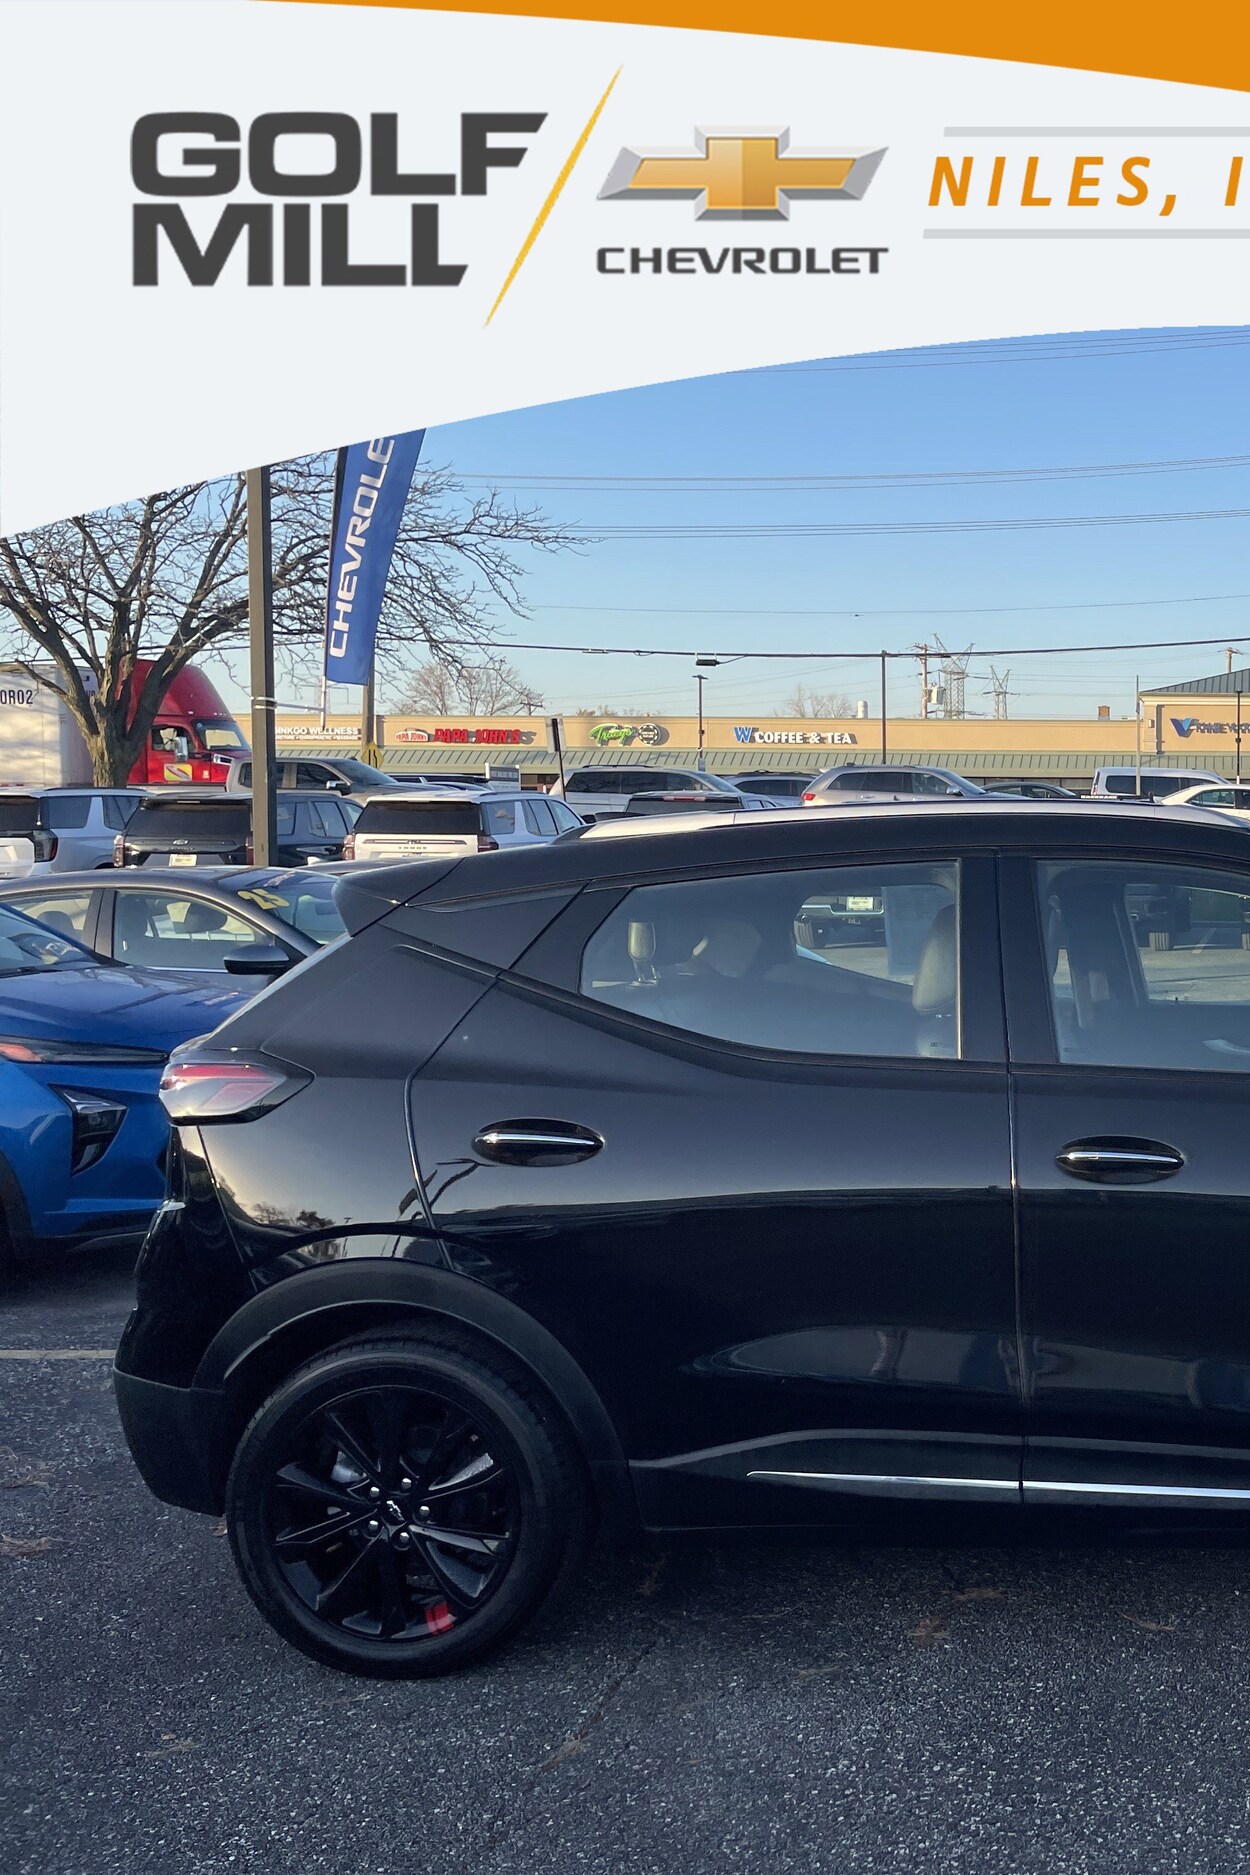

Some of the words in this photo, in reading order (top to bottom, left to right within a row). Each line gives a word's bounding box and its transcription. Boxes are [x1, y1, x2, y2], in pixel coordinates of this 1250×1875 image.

[309, 726, 359, 735] WELLNESS
[433, 728, 468, 743] PAPA
[733, 726, 752, 743] W
[754, 731, 804, 744] COFFEE
[808, 732, 821, 743] &
[826, 732, 853, 744] TEA
[237, 887, 291, 911] 25
